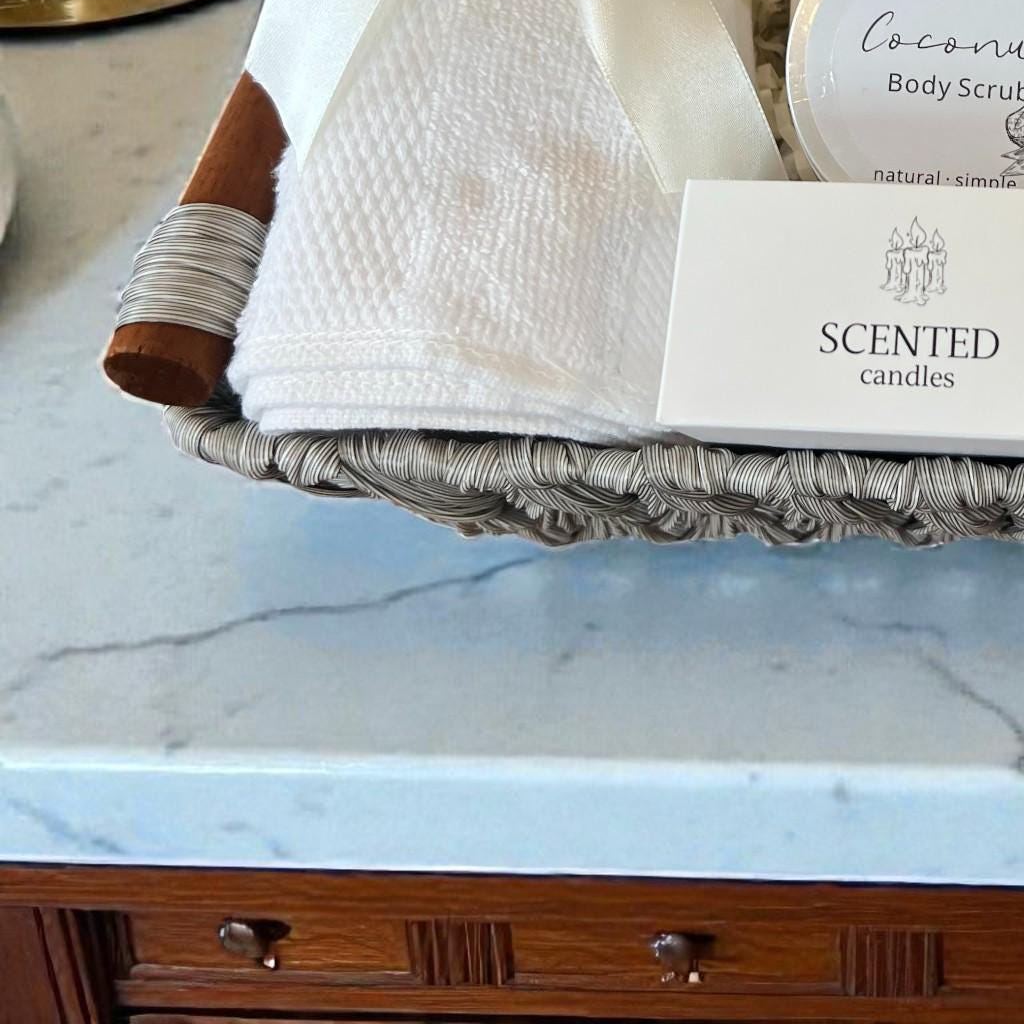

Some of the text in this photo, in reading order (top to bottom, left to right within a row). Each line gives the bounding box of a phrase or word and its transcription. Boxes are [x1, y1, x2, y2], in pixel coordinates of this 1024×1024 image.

[888, 73, 951, 101] Body
[873, 169, 941, 186] natural
[819, 322, 1000, 360] SCENTED
[860, 364, 955, 389] candles
